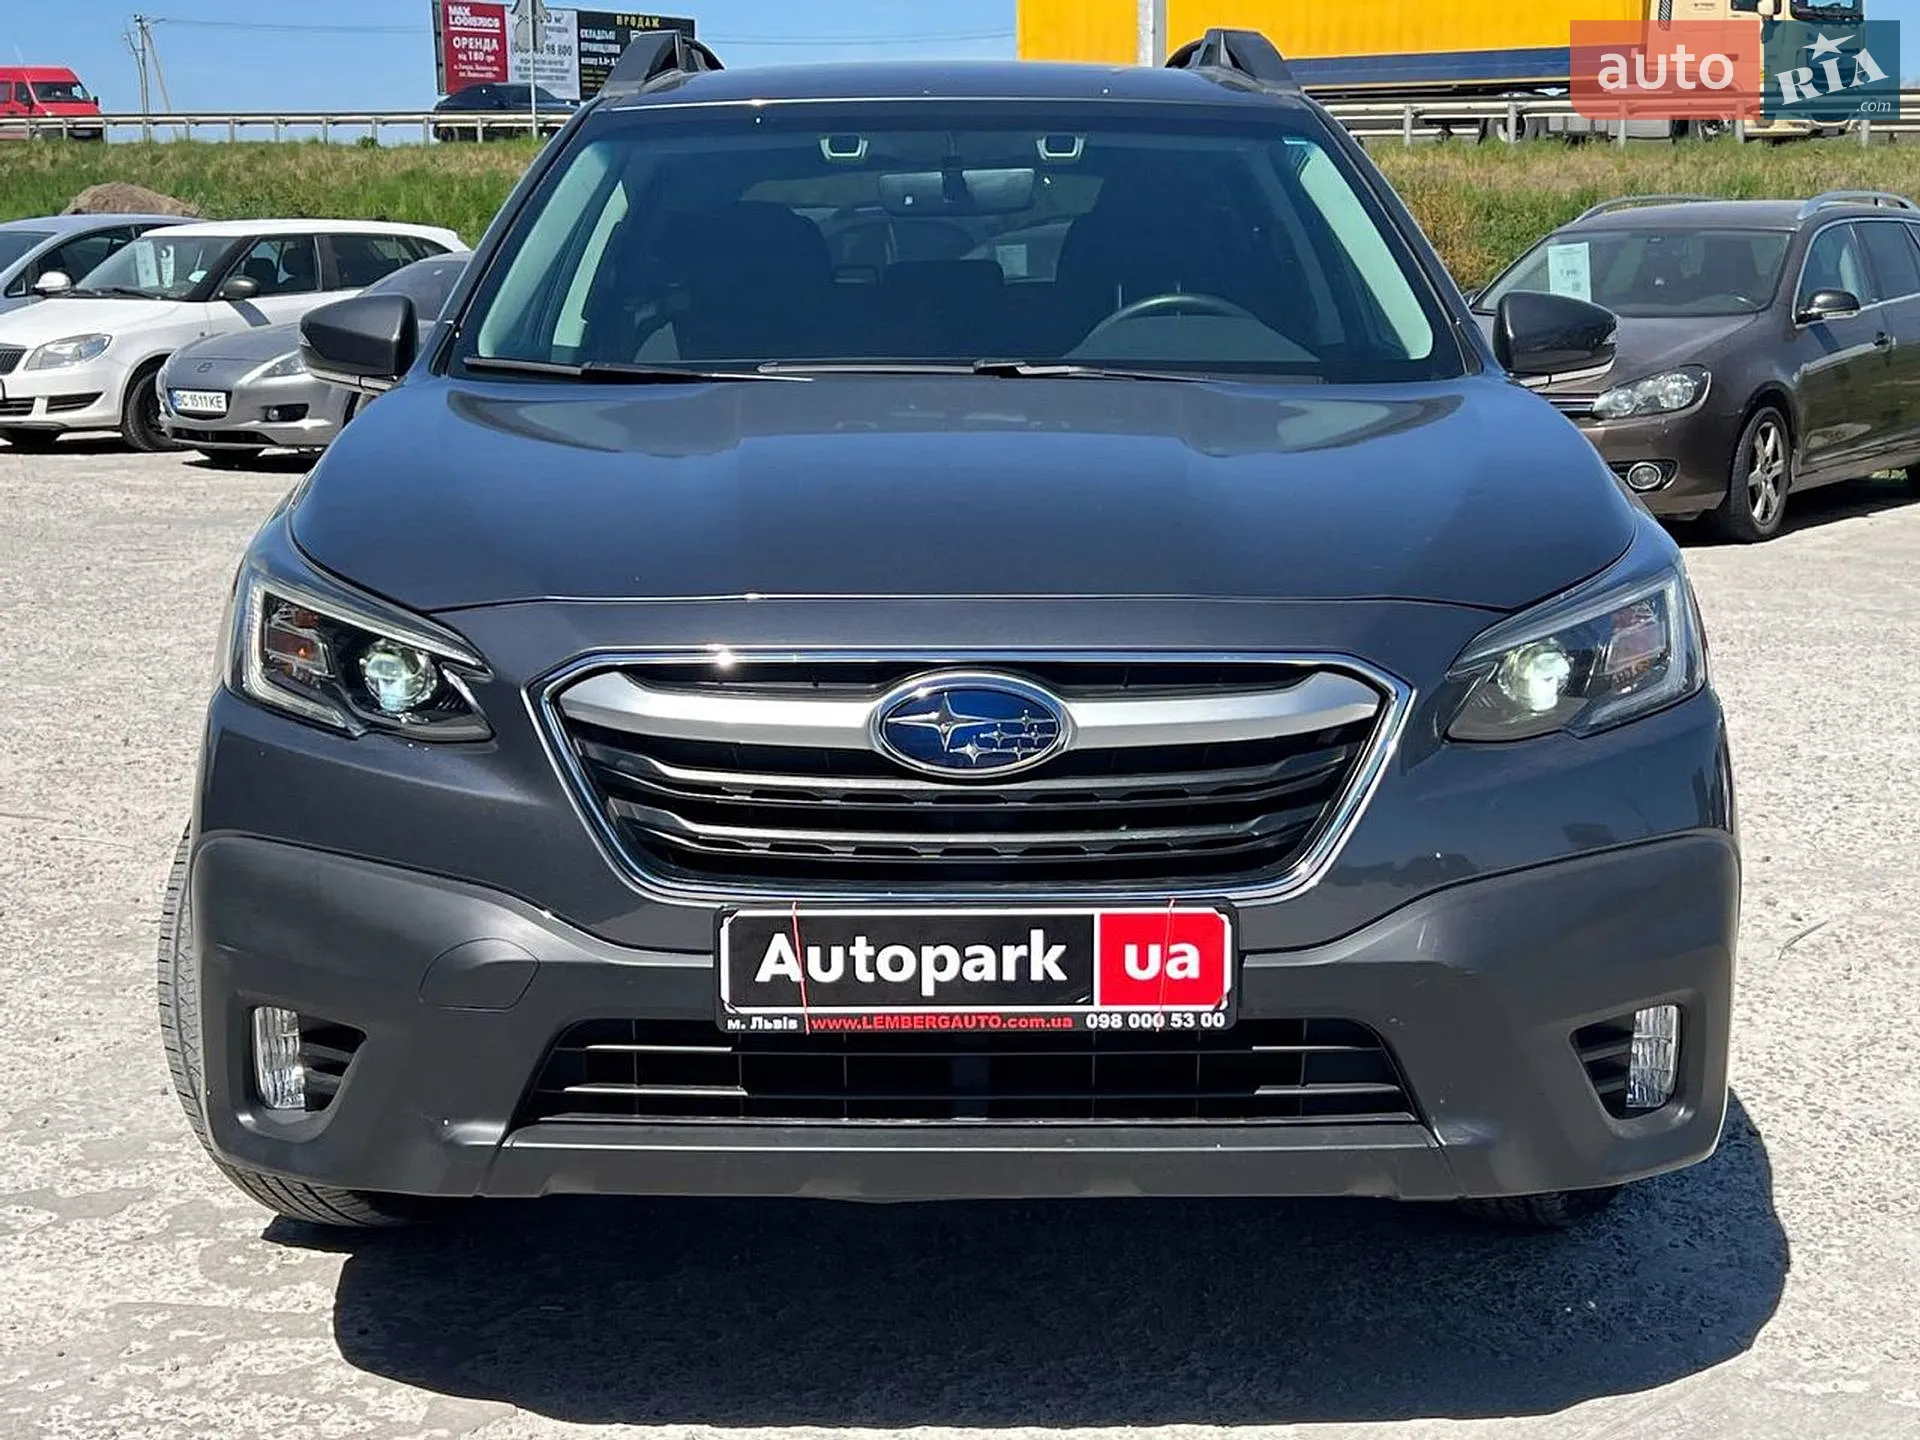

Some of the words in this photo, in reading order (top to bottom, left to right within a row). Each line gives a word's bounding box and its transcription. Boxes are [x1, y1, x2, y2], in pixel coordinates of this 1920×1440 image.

[448, 5, 471, 16] MAX
[616, 15, 660, 29] ПРОДАЖ
[452, 36, 500, 52] ОРЕНДА
[467, 50, 485, 62] 180
[753, 929, 1068, 998] Autopark
[1123, 941, 1200, 980] ua
[727, 1018, 746, 1030] м.
[750, 1014, 798, 1030] Львів
[811, 1013, 1073, 1030] www.LEMBERGAUTO.com.ua
[1085, 1013, 1123, 1029] 098
[1128, 1013, 1166, 1029] 000
[1170, 1013, 1197, 1029] 53
[1200, 1012, 1226, 1028] 00
